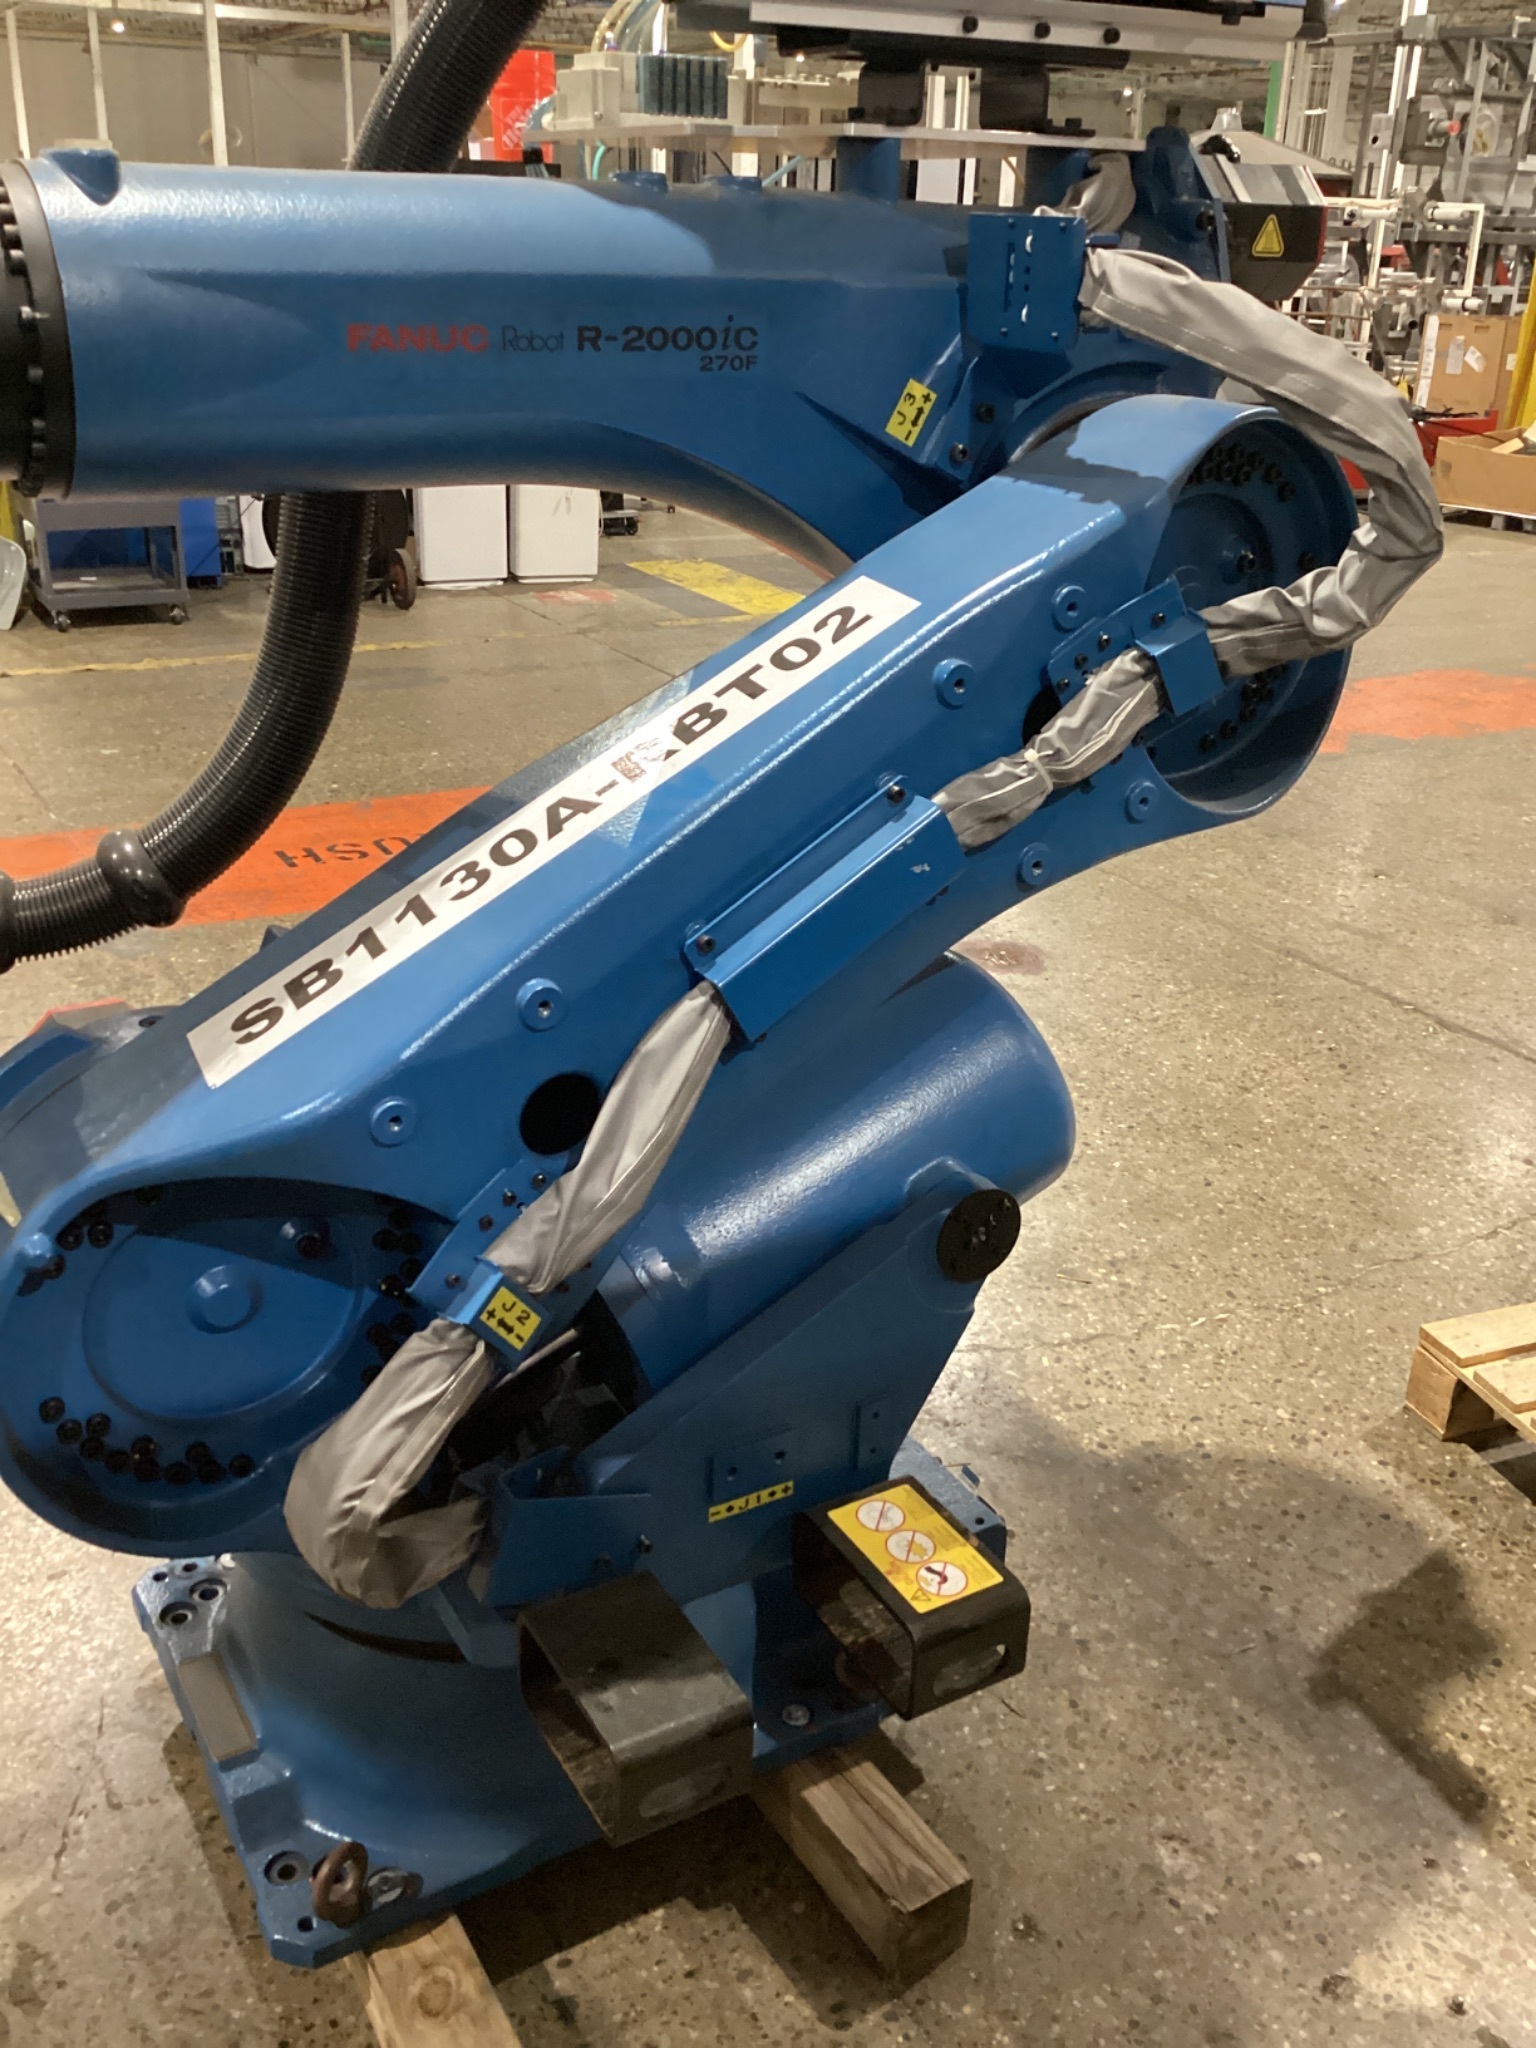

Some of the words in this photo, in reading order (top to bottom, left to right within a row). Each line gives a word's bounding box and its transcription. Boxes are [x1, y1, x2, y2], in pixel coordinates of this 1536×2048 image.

[346, 322, 490, 354] FANUC
[501, 324, 565, 353] Robot
[576, 314, 759, 353] R-2000iC
[700, 355, 758, 373] 270F
